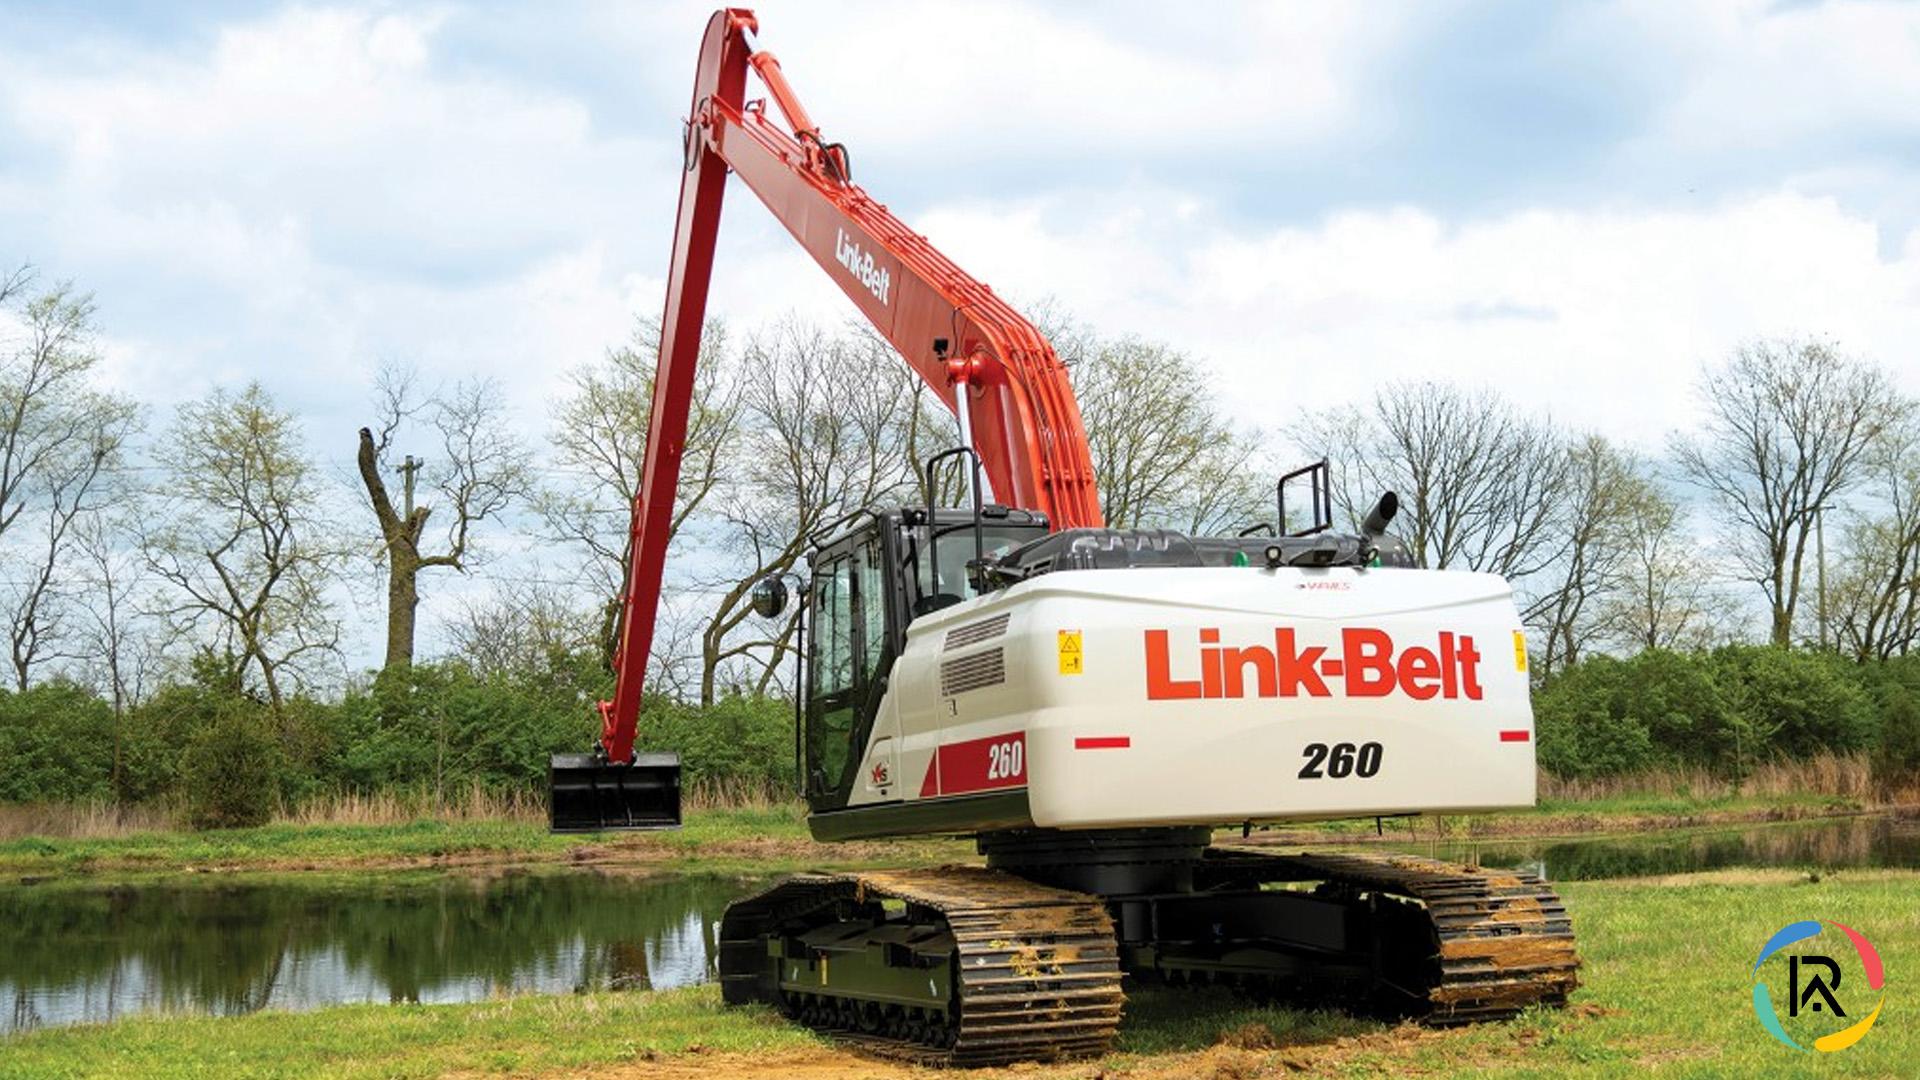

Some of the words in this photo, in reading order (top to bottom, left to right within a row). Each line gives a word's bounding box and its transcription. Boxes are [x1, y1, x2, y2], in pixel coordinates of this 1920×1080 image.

[836, 228, 890, 306] Link-Belt
[1145, 628, 1483, 701] Link-Belt
[988, 740, 1023, 779] 260
[1298, 742, 1383, 779] 260
